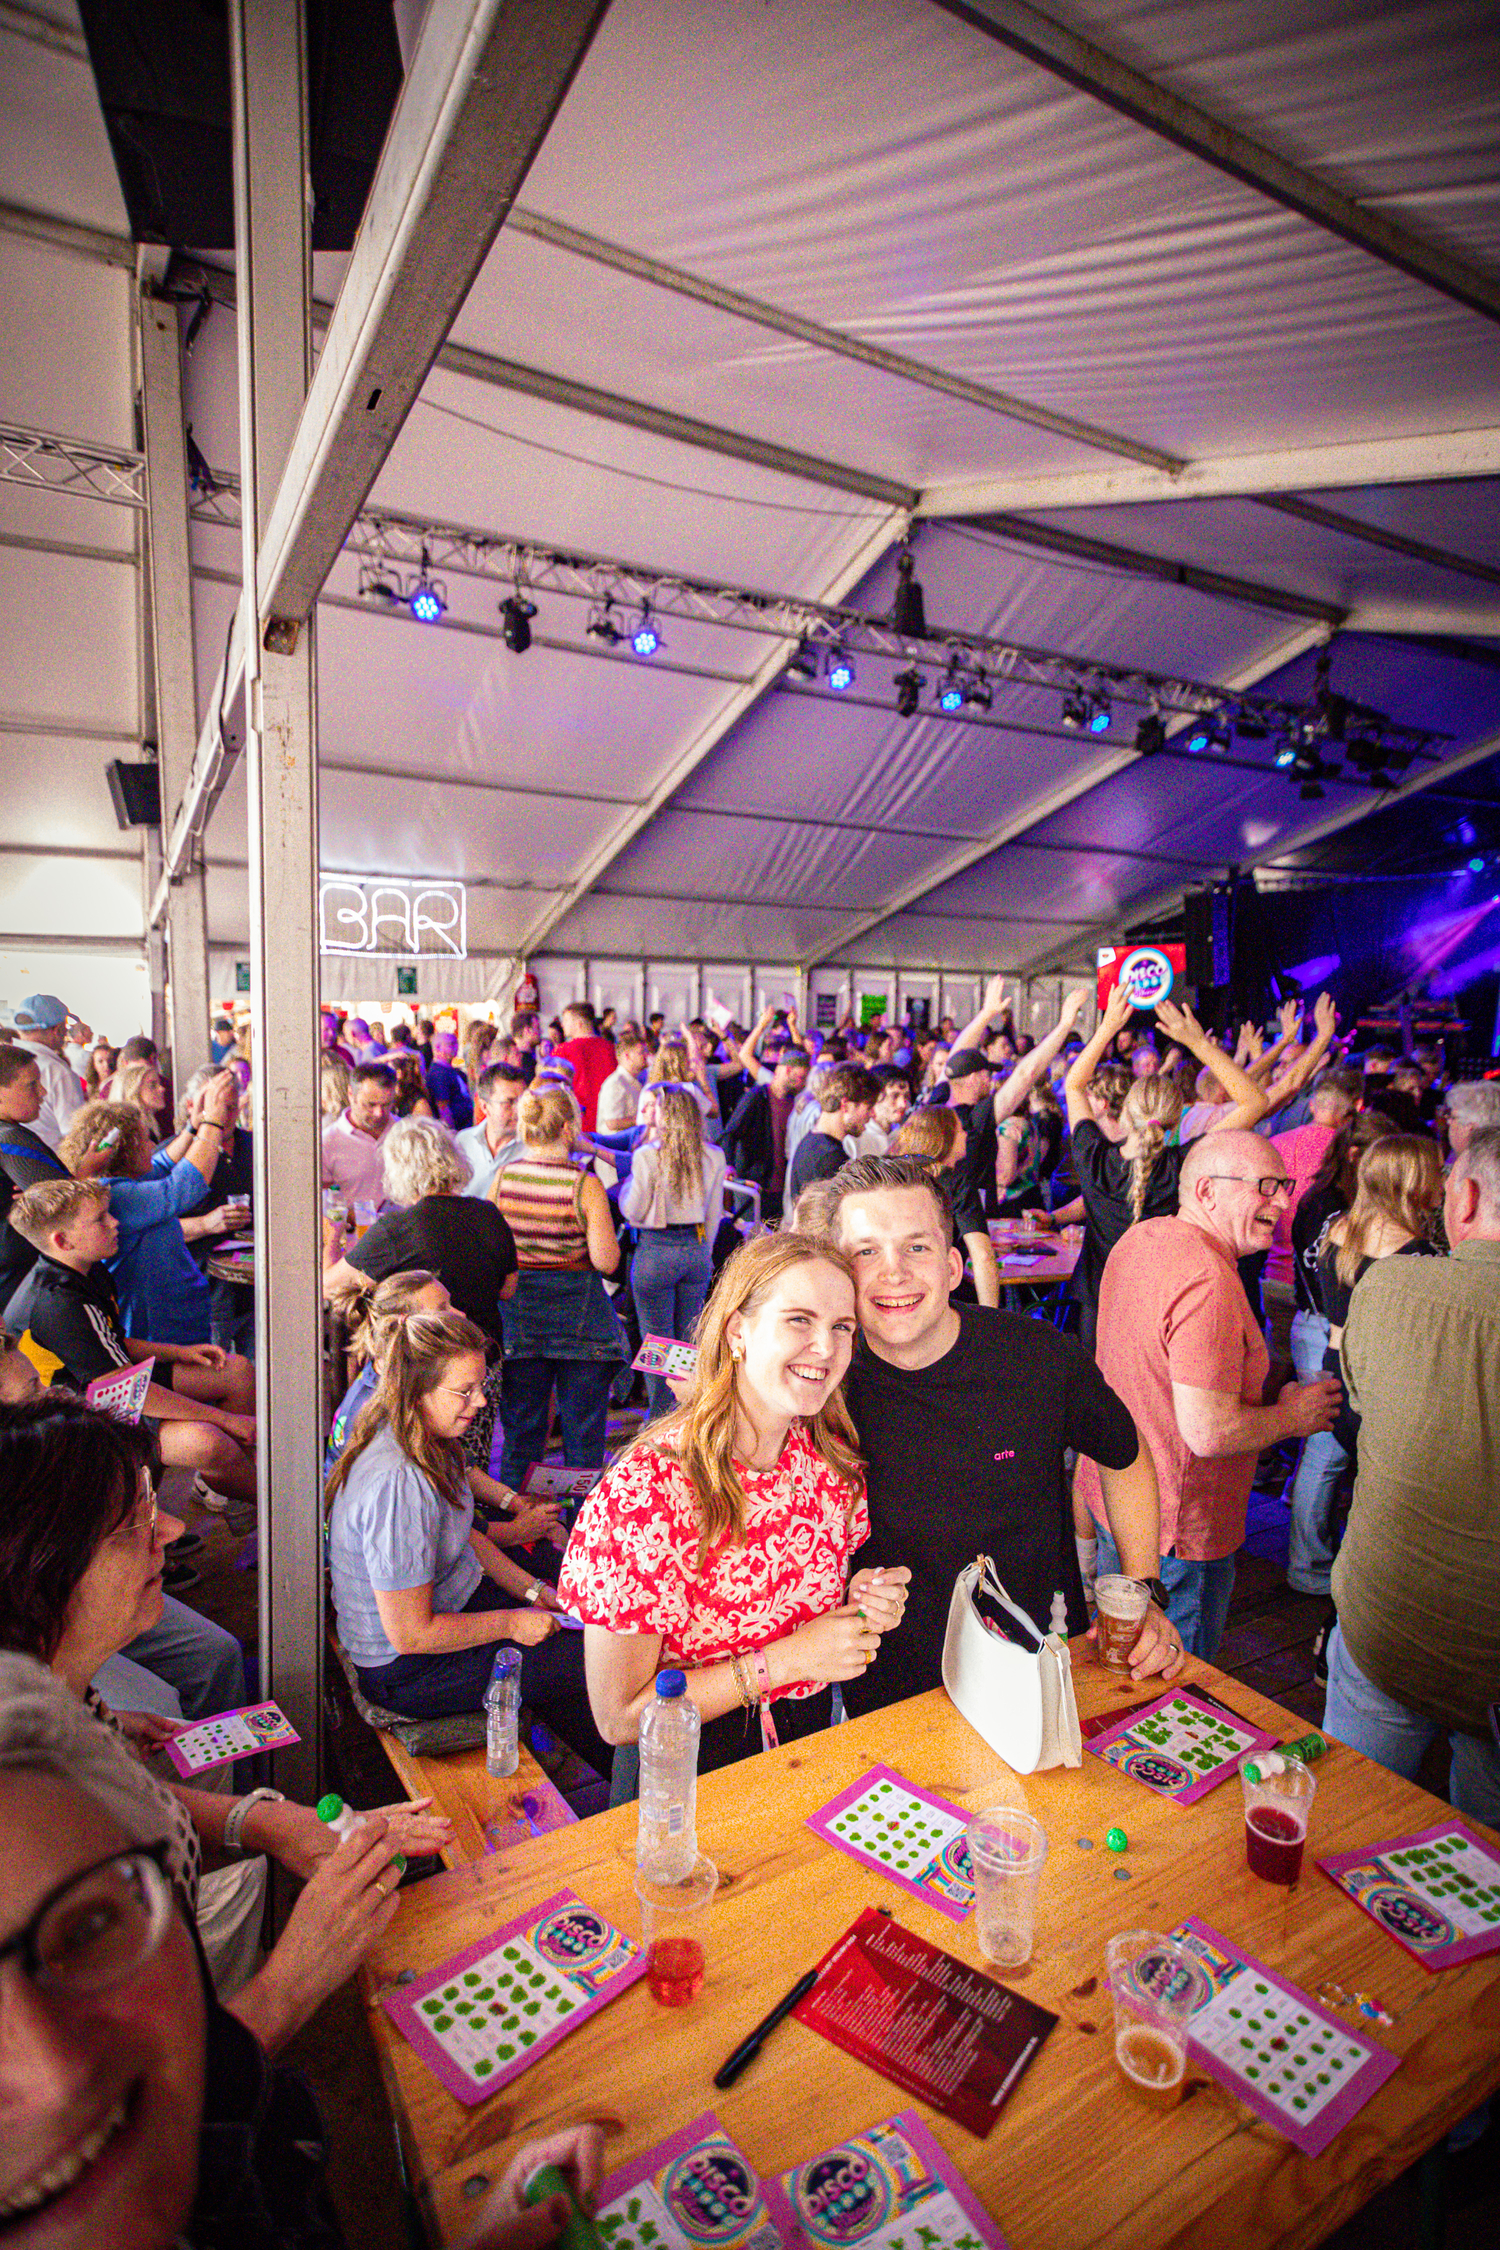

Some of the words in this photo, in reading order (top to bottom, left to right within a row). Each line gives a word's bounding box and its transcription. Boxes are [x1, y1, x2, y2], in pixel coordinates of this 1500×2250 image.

[320, 882, 461, 954] BAR
[994, 1449, 1015, 1461] arte
[572, 1473, 594, 1492] 150
[551, 1916, 605, 1949] DISCO
[685, 2157, 755, 2218] DISCO
[800, 2157, 869, 2218] DISCO
